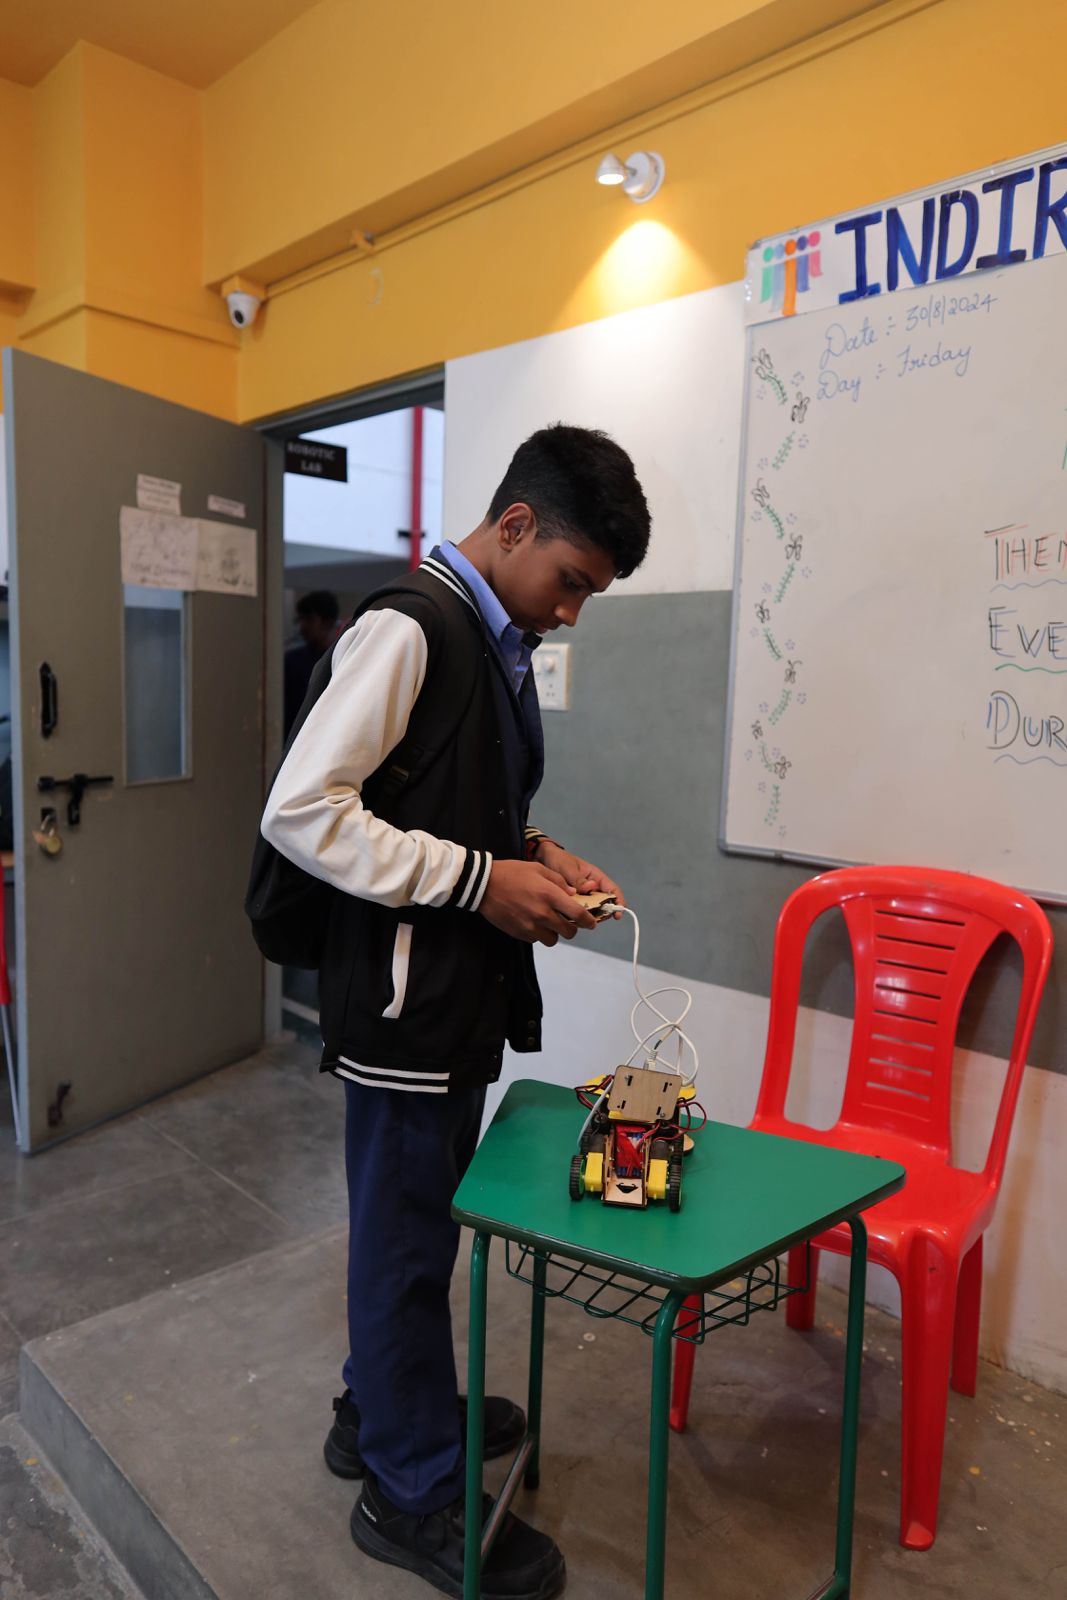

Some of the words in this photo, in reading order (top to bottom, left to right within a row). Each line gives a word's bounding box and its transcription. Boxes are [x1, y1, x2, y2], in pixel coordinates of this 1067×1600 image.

[819, 317, 877, 370] Date
[905, 293, 998, 331] 30/8/2024
[816, 370, 861, 402] Day
[897, 341, 971, 377] Friday
[287, 441, 336, 461] ROBOTIC
[301, 459, 322, 473] LAB
